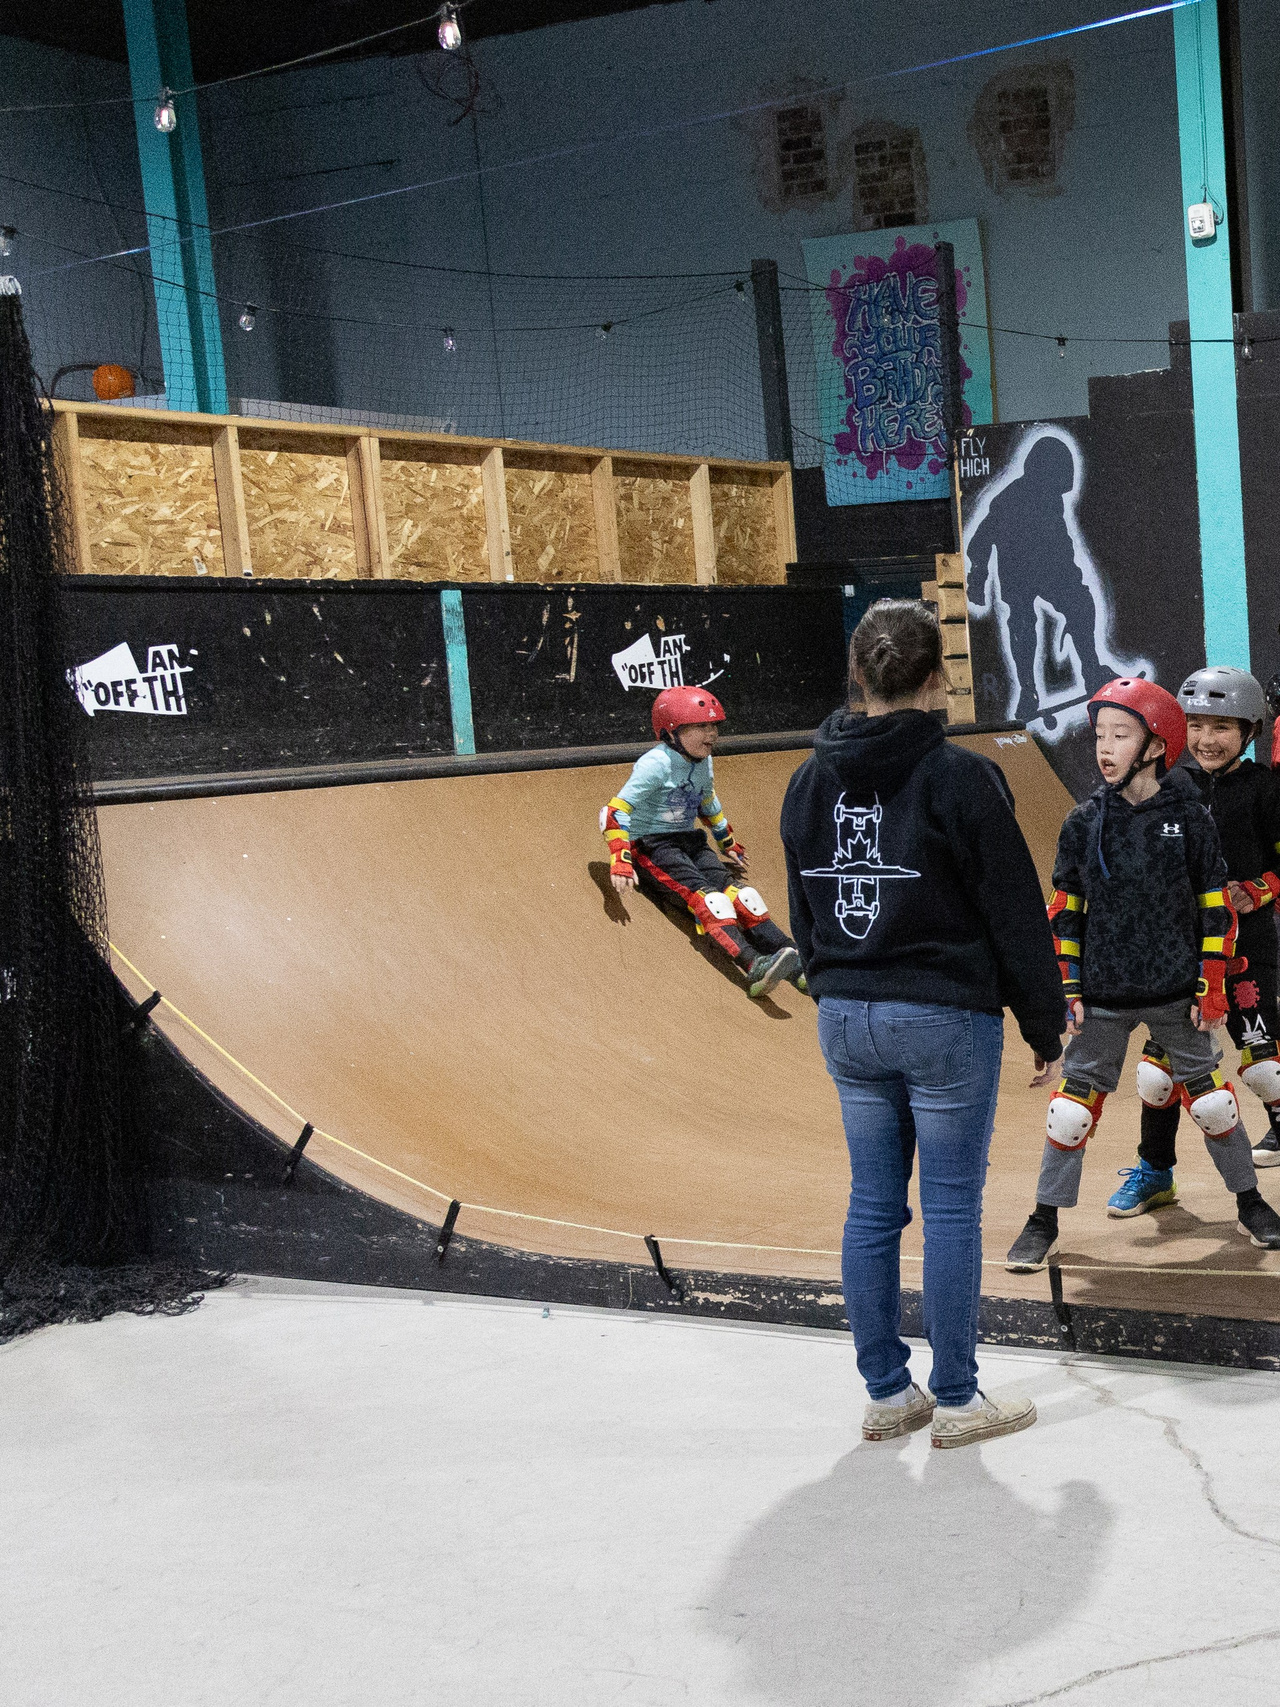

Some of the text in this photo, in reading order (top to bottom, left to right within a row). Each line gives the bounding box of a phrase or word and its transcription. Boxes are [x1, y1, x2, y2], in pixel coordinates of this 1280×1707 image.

[847, 272, 940, 334] HAVE
[845, 324, 941, 364] YOUR
[961, 437, 986, 456] FLY
[961, 457, 990, 478] HIGH
